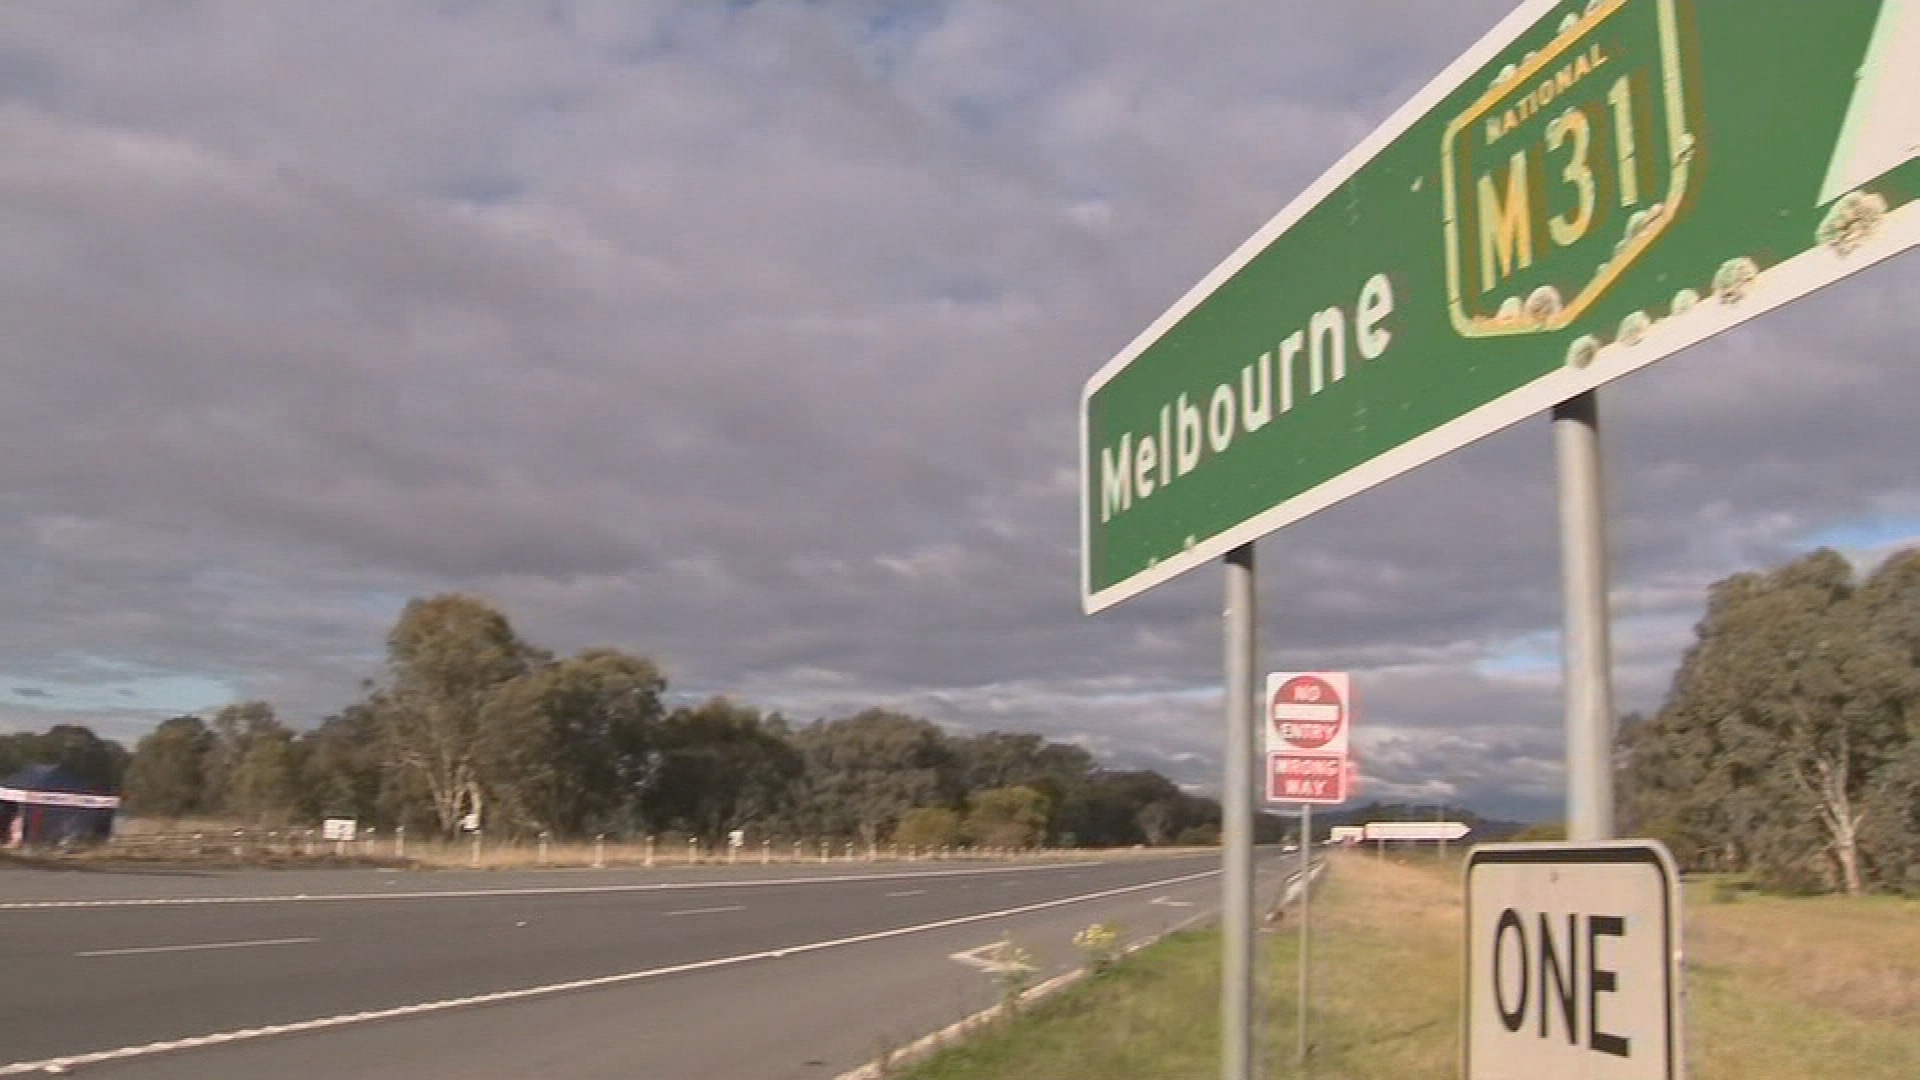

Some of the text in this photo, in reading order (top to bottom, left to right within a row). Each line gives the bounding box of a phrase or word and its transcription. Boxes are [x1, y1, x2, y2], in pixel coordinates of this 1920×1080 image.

[1485, 44, 1608, 144] NATIONAL
[1101, 273, 1394, 523] Melbourne
[1294, 685, 1321, 701] NO
[1280, 723, 1337, 740] ENTRY
[1275, 759, 1338, 776] WRONG
[1285, 779, 1327, 795] WAY
[1493, 907, 1630, 1057] ONE
